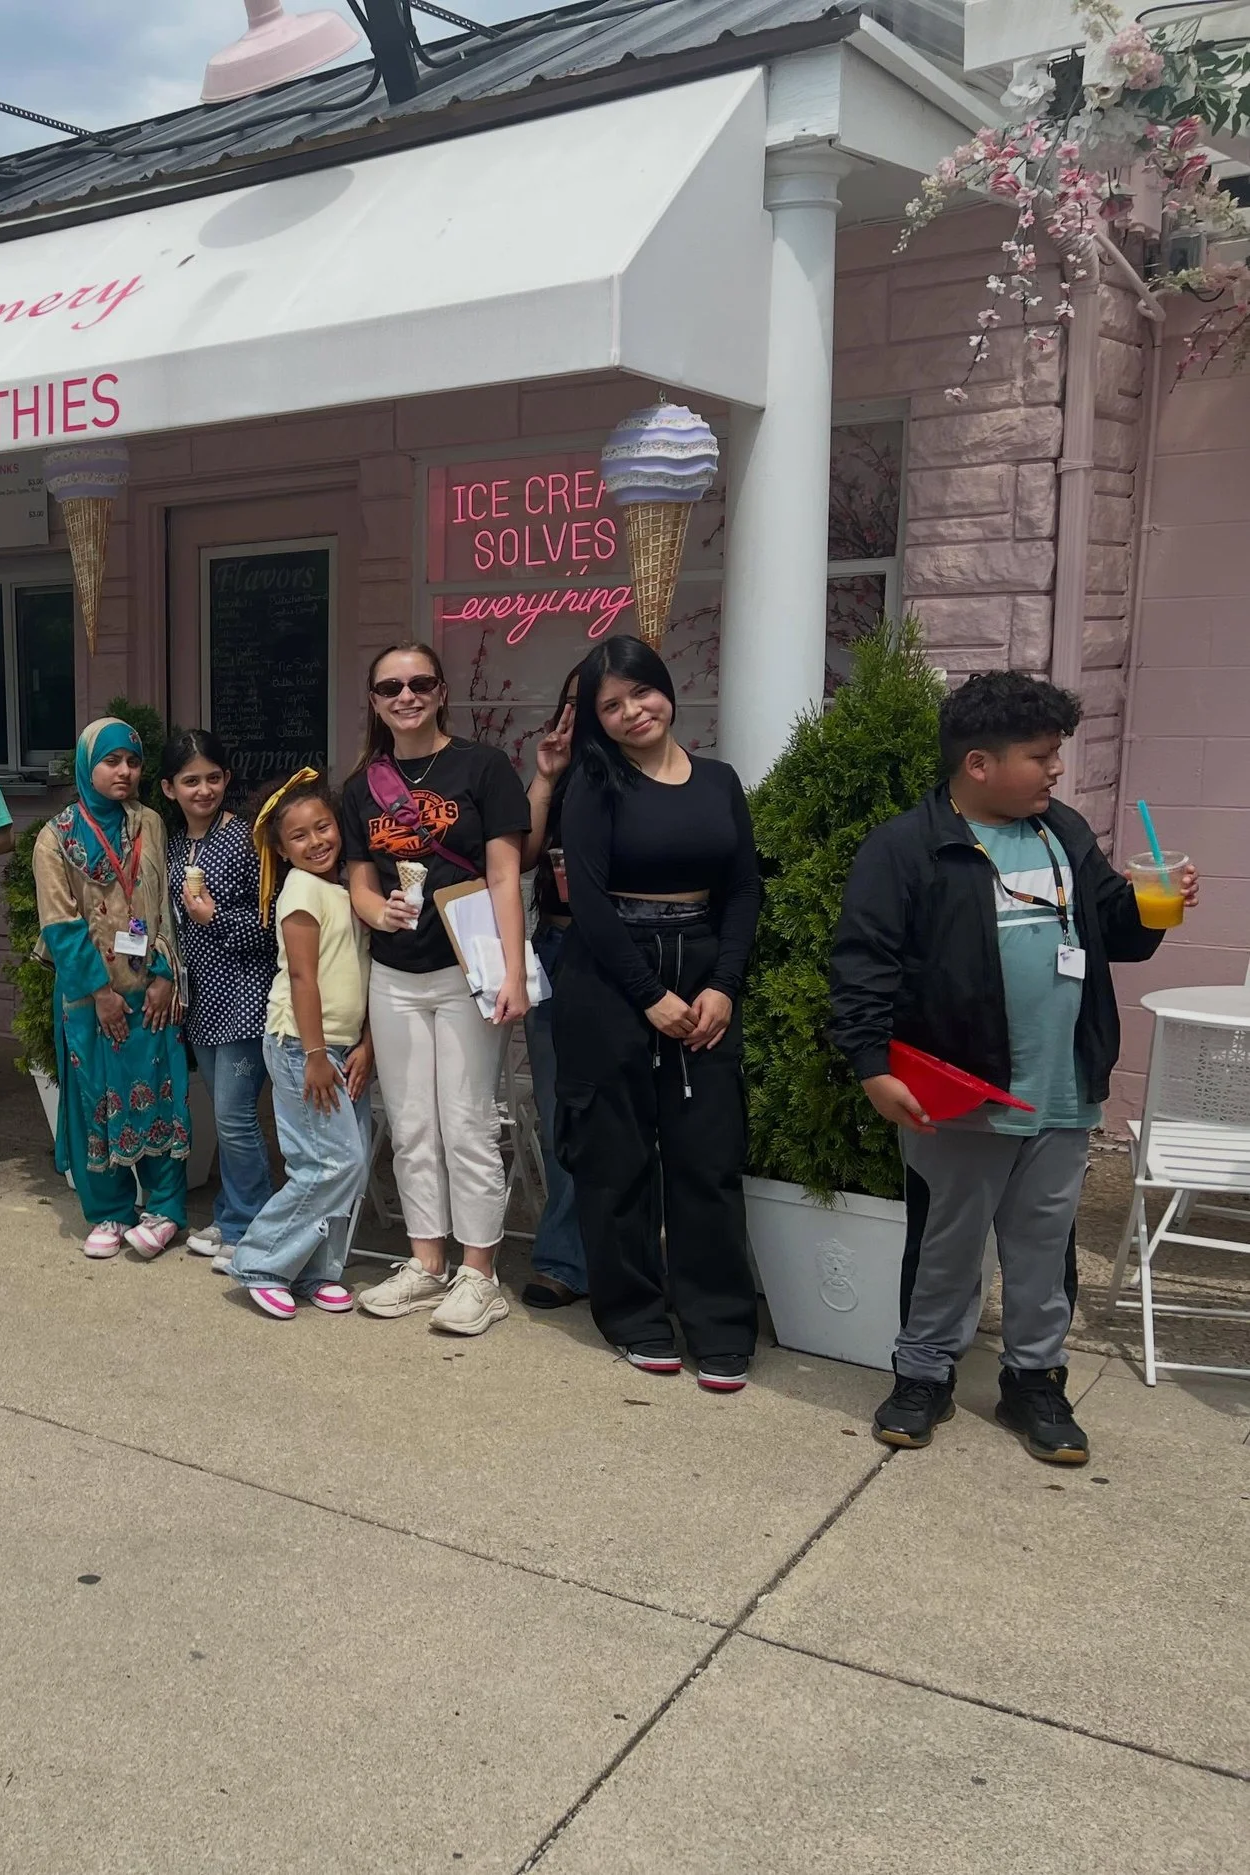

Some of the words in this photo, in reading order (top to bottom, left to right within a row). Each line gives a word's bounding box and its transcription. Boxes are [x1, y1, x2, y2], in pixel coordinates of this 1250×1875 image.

[452, 480, 510, 523] ICE
[474, 518, 617, 570] SOLVES
[215, 561, 317, 593] Flavors
[442, 566, 635, 645] everything
[370, 801, 458, 836] ROETS
